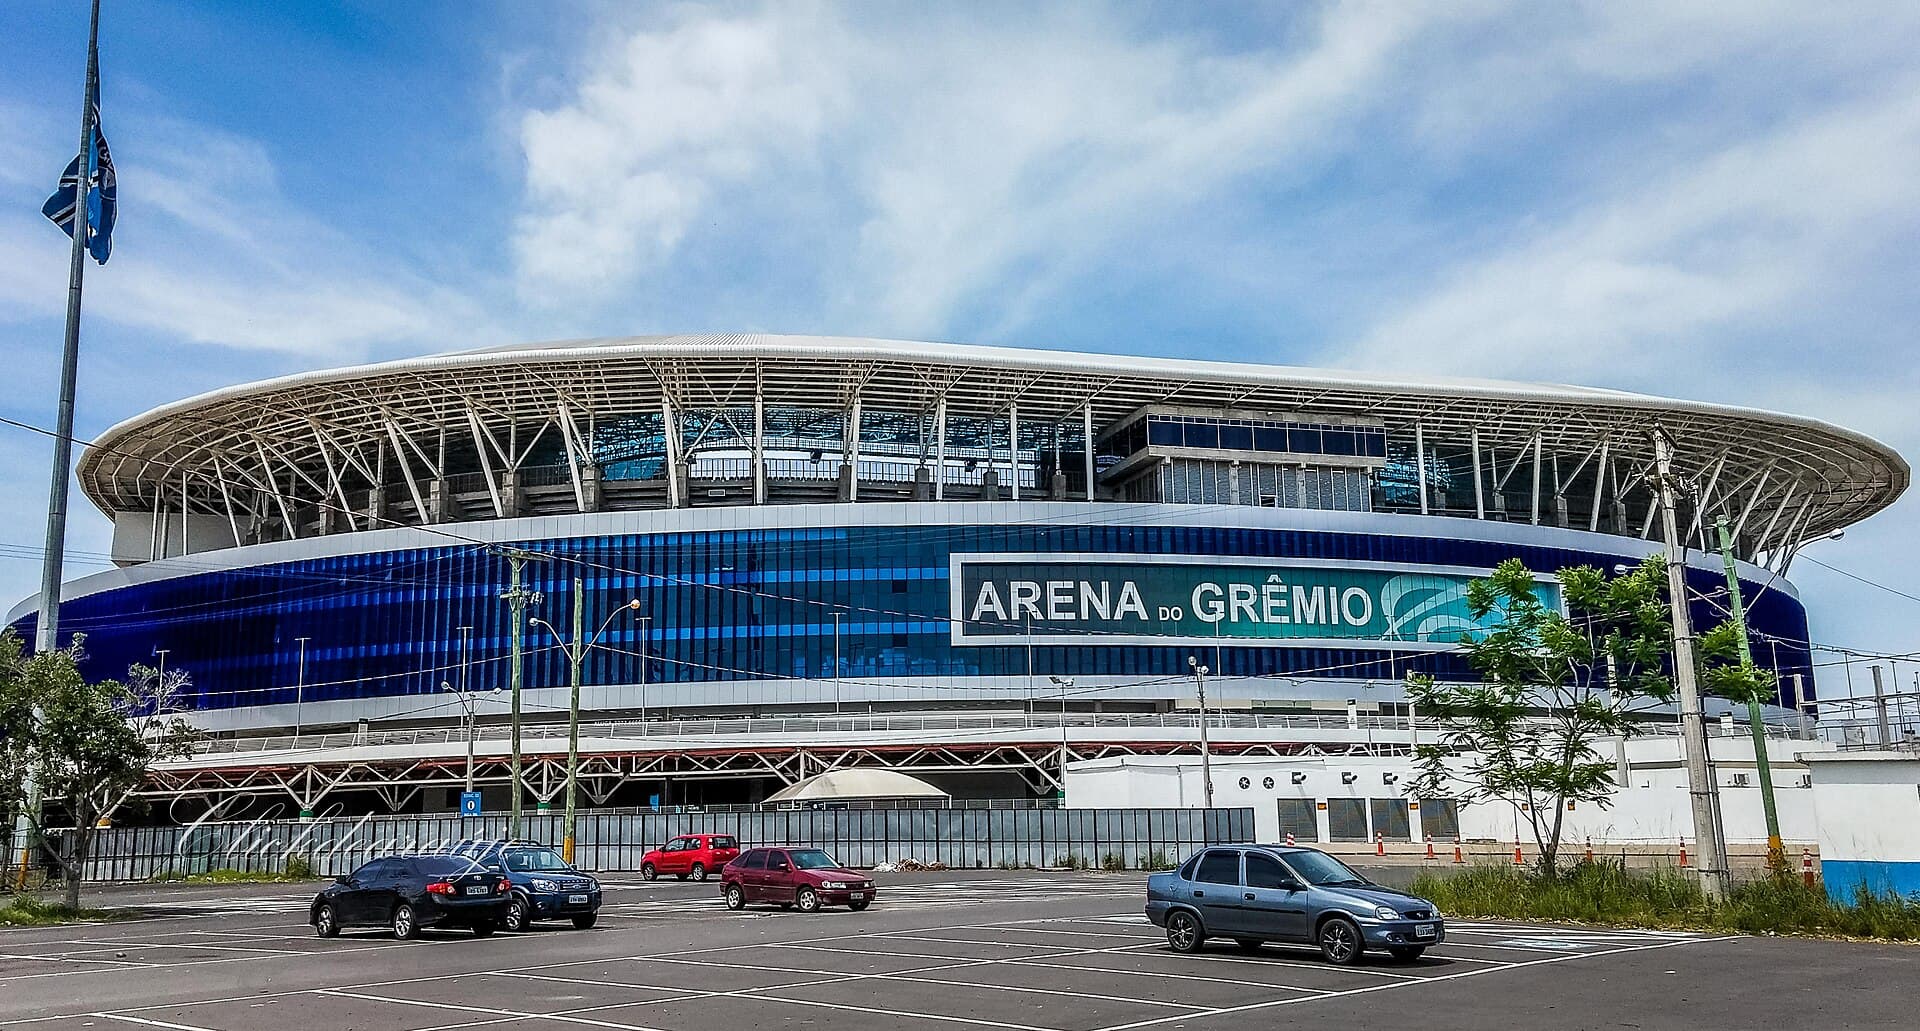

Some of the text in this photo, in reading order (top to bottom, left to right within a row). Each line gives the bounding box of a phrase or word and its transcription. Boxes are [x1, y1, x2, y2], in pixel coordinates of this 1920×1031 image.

[970, 574, 1373, 626] ARENA DO GRÊMIO
